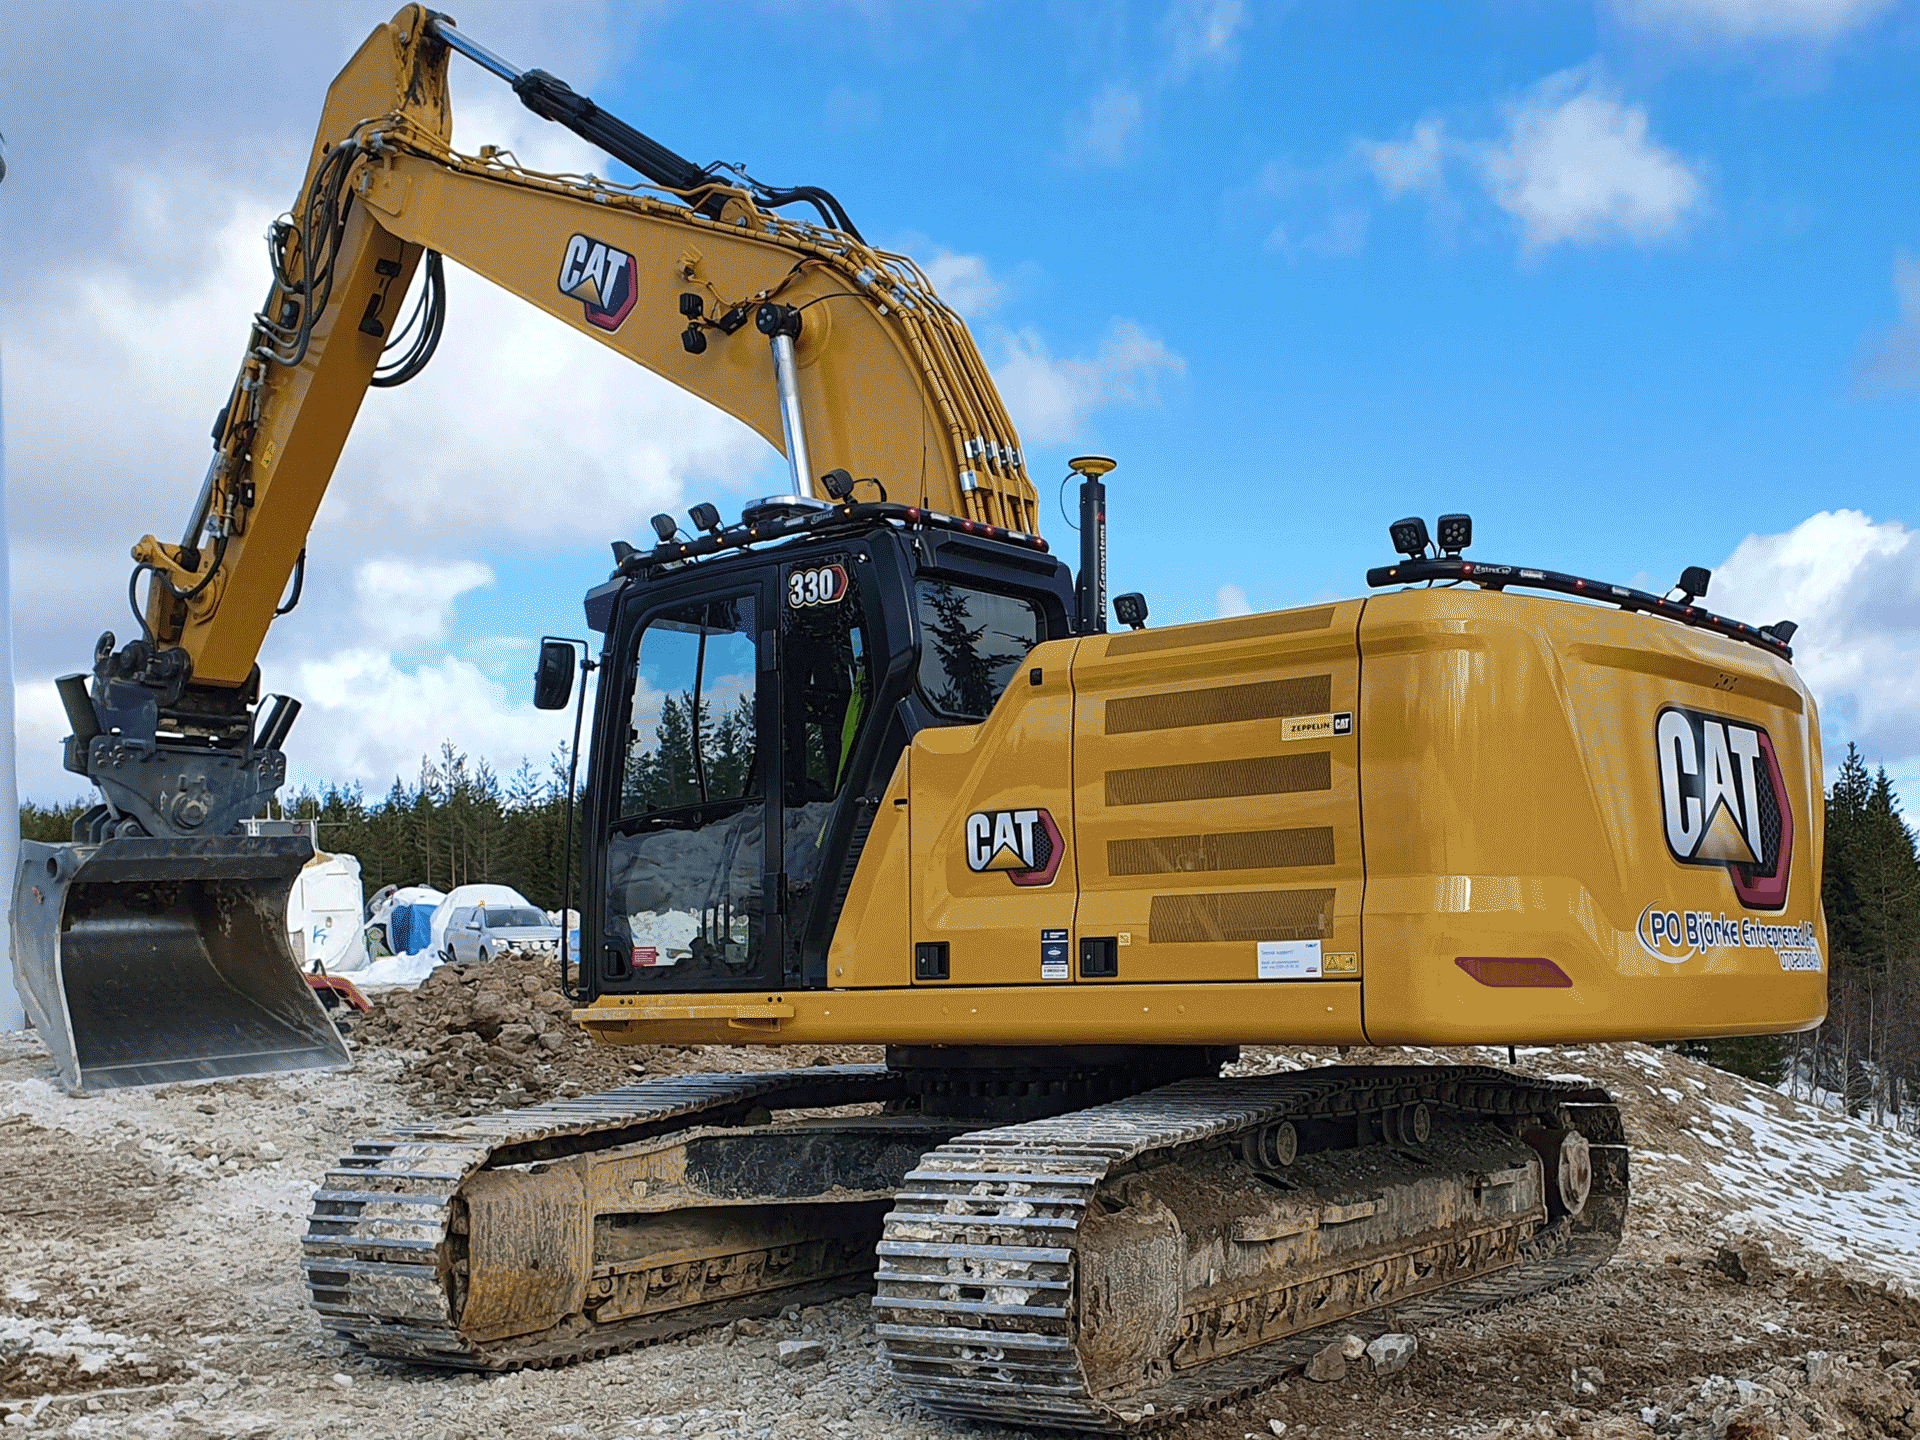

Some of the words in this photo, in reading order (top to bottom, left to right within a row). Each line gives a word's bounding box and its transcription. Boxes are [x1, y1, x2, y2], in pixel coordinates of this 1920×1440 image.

[560, 234, 628, 310] CAT
[790, 568, 833, 605] 330
[1291, 723, 1330, 732] ZEPPELIN
[1335, 718, 1349, 730] CAT
[1658, 711, 1763, 864] CAT
[967, 810, 1038, 871] CAT
[1650, 912, 1682, 946] PO
[1684, 911, 1740, 953] Björke
